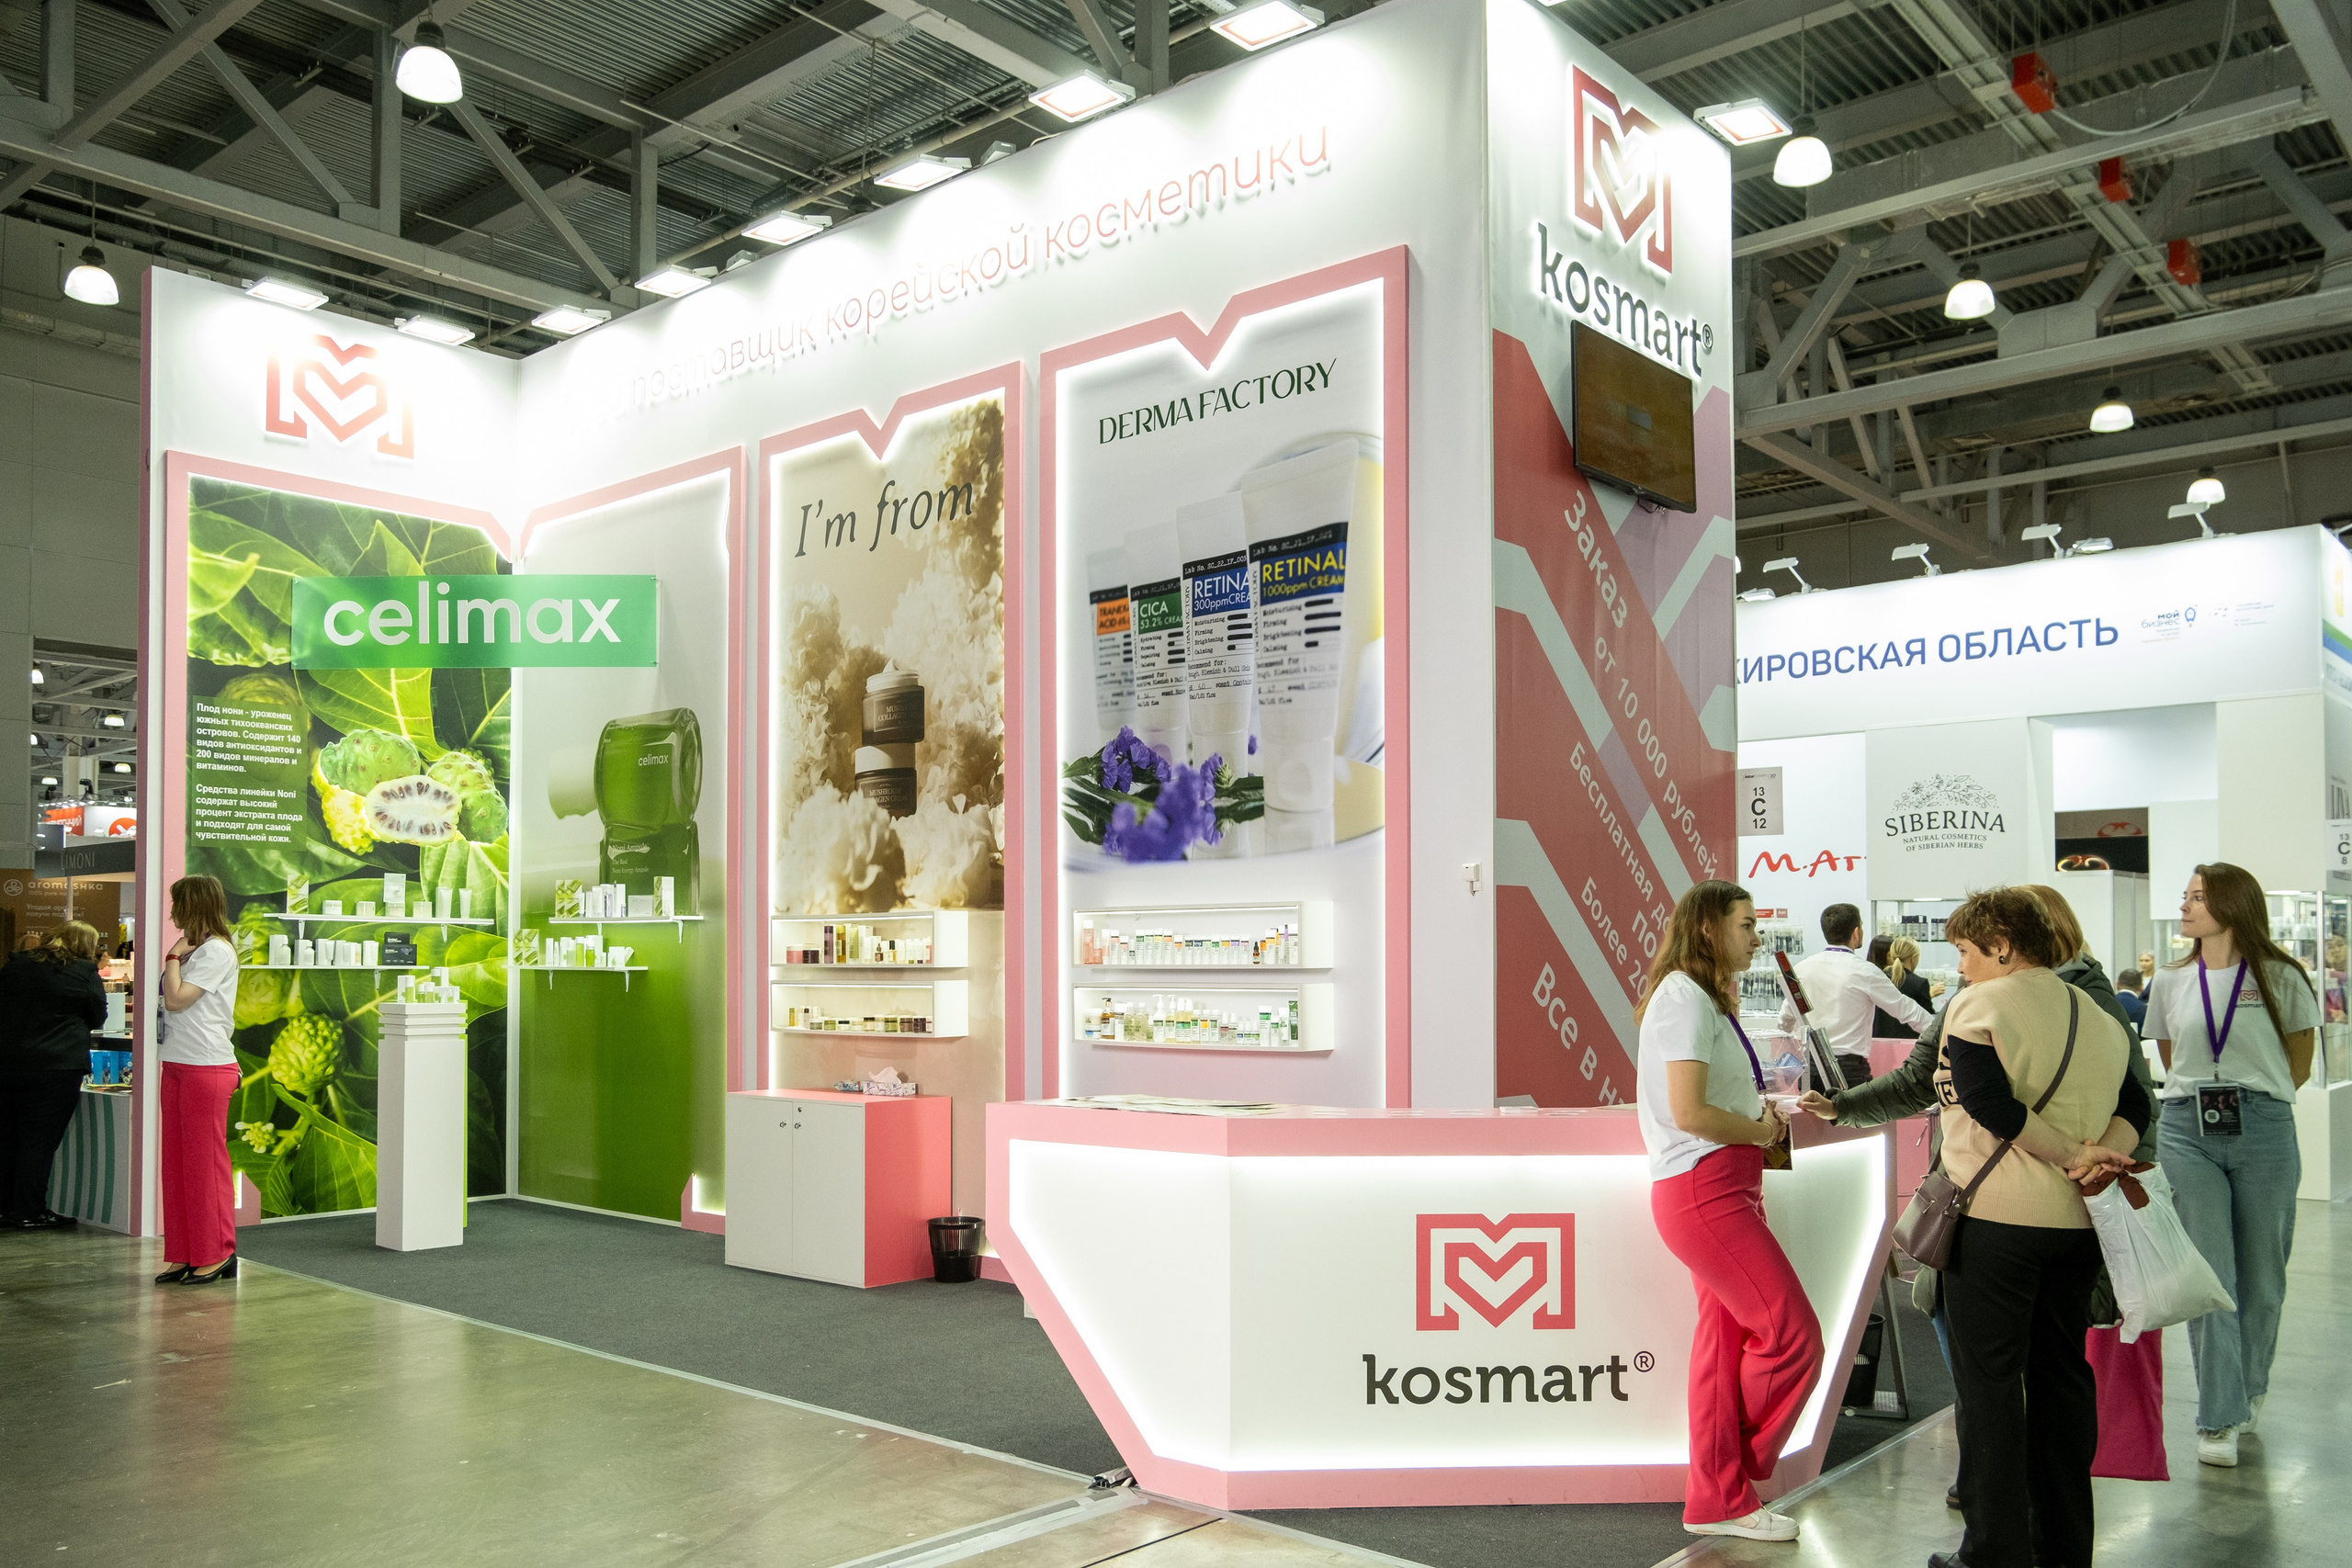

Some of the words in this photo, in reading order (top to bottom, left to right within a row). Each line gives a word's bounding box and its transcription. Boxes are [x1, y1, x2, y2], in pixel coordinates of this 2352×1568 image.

[632, 315, 814, 405] поставщик
[827, 222, 1029, 336] корейской
[1046, 126, 1328, 260] косметики
[1099, 397, 1194, 446] DERMA
[1198, 357, 1338, 420] FACTORY
[868, 479, 973, 552] from
[1262, 549, 1345, 584] RETINAL
[1564, 489, 1628, 628] Заказ
[323, 581, 622, 647] celimax
[1139, 601, 1169, 618] CICA
[1938, 616, 2120, 663] ОБЛАСТЬ
[1595, 637, 1616, 673] от
[1617, 677, 1638, 719] 10
[196, 703, 220, 715] Плод
[221, 706, 244, 716] нони
[250, 709, 292, 722] уроженец
[196, 716, 229, 727] южных
[231, 719, 294, 732] тихоокеанских
[196, 728, 241, 739] островов.
[242, 729, 285, 742] Содержит
[287, 735, 301, 743] 140
[196, 739, 224, 749] видов
[226, 741, 295, 754] антиоксидантов
[1636, 717, 1668, 779] 000
[196, 749, 212, 758] 200
[213, 751, 241, 761] видов
[243, 754, 290, 765] минералов
[638, 753, 669, 767] celimax
[196, 761, 247, 773] витаминов.
[196, 783, 238, 795] Средства
[239, 788, 276, 797] линейки
[277, 789, 297, 798] Noni
[1752, 786, 1766, 796] 13
[196, 796, 238, 807] содержат
[239, 799, 277, 808] высокий
[1750, 797, 1767, 816] C
[196, 808, 232, 818] процент
[233, 810, 276, 820] экстракта
[277, 813, 303, 822] плода
[1569, 740, 1654, 902] Бесплатная
[1752, 818, 1767, 829] 12
[1884, 809, 2006, 837] SIBERINA
[203, 820, 245, 829] подходят
[265, 823, 292, 832] самой
[1663, 779, 1718, 881] рублей
[196, 831, 266, 842] чувствительной
[268, 835, 292, 843] кожи.
[1903, 833, 1939, 845] NATURAL
[1941, 833, 1987, 841] COSMETICS
[1917, 842, 1955, 851] SIBERIAN
[1957, 841, 1984, 850] HERBS
[60, 852, 96, 871] LIMONI
[1580, 875, 1628, 965] Более
[1532, 961, 1578, 1050] Все
